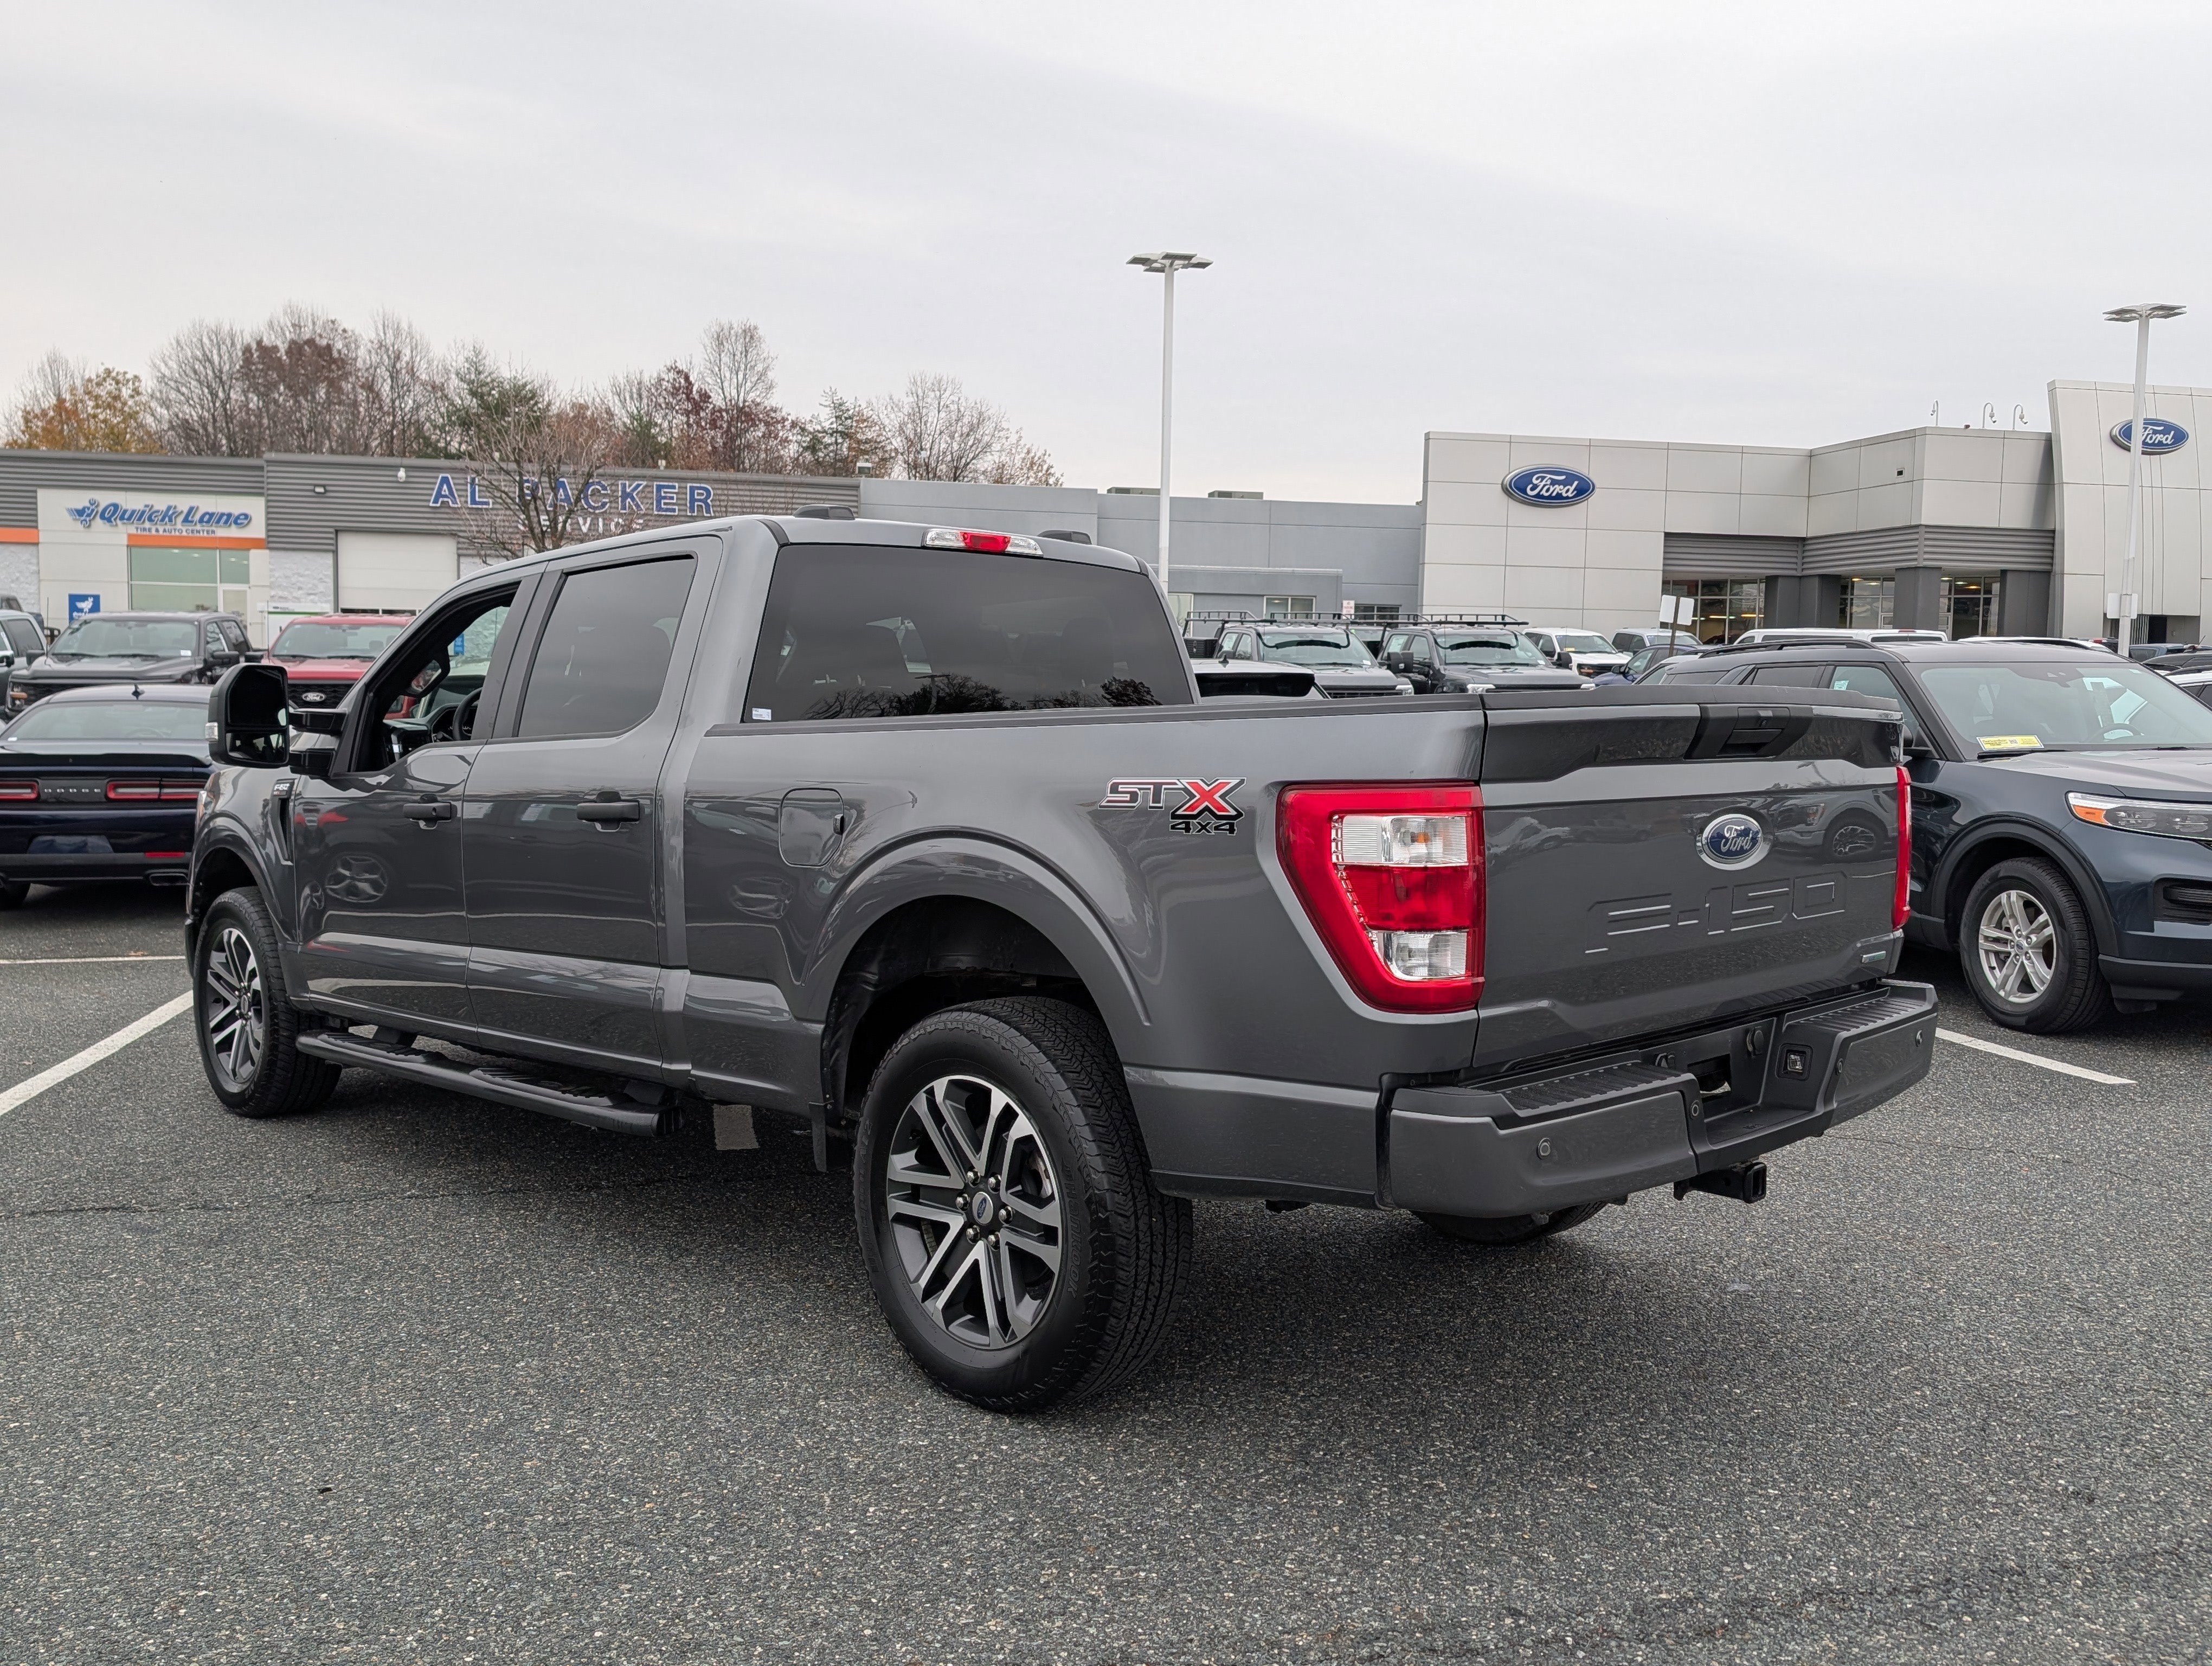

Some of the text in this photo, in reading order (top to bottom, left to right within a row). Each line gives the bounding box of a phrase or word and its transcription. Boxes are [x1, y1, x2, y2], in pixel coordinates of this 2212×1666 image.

[2142, 425, 2175, 444] Ford
[430, 474, 492, 509] AL
[1526, 473, 1579, 498] Ford
[99, 502, 252, 528] Quick Lane
[1097, 777, 1248, 821] STX
[1720, 824, 1753, 853] Ford
[1585, 870, 1847, 953] F-150
